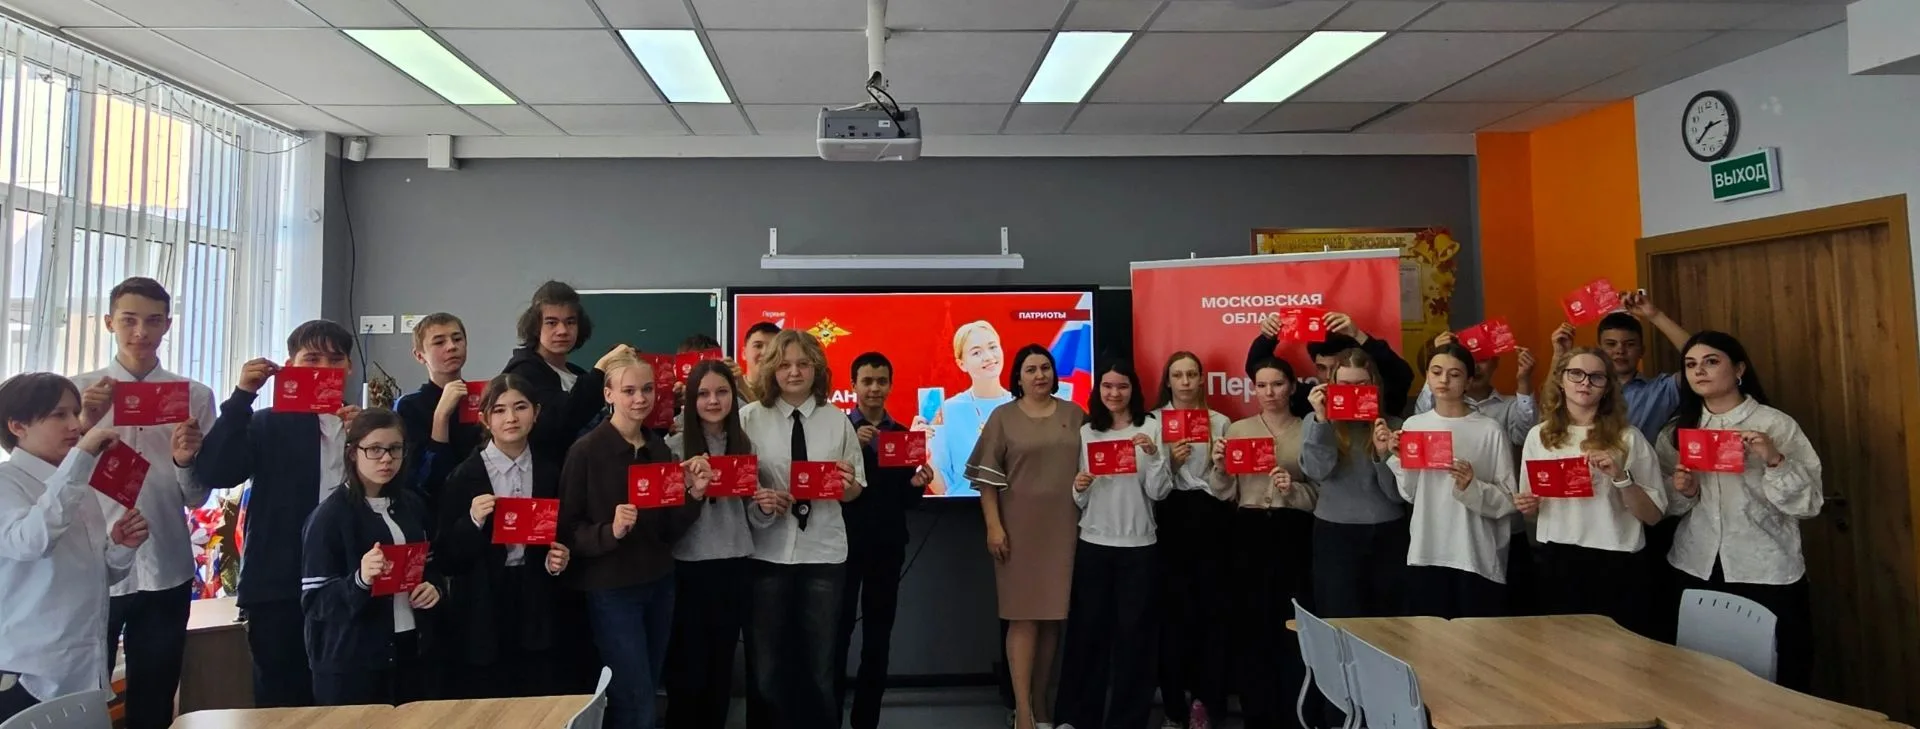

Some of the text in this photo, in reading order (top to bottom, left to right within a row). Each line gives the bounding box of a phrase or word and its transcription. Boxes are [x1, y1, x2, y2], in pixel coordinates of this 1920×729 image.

[1714, 162, 1767, 188] ВЫХОД
[1201, 293, 1323, 308] МОСКОВСКАЯ
[1018, 311, 1067, 319] ПАТРИОТЫ
[1222, 312, 1280, 325] ОБЛА
